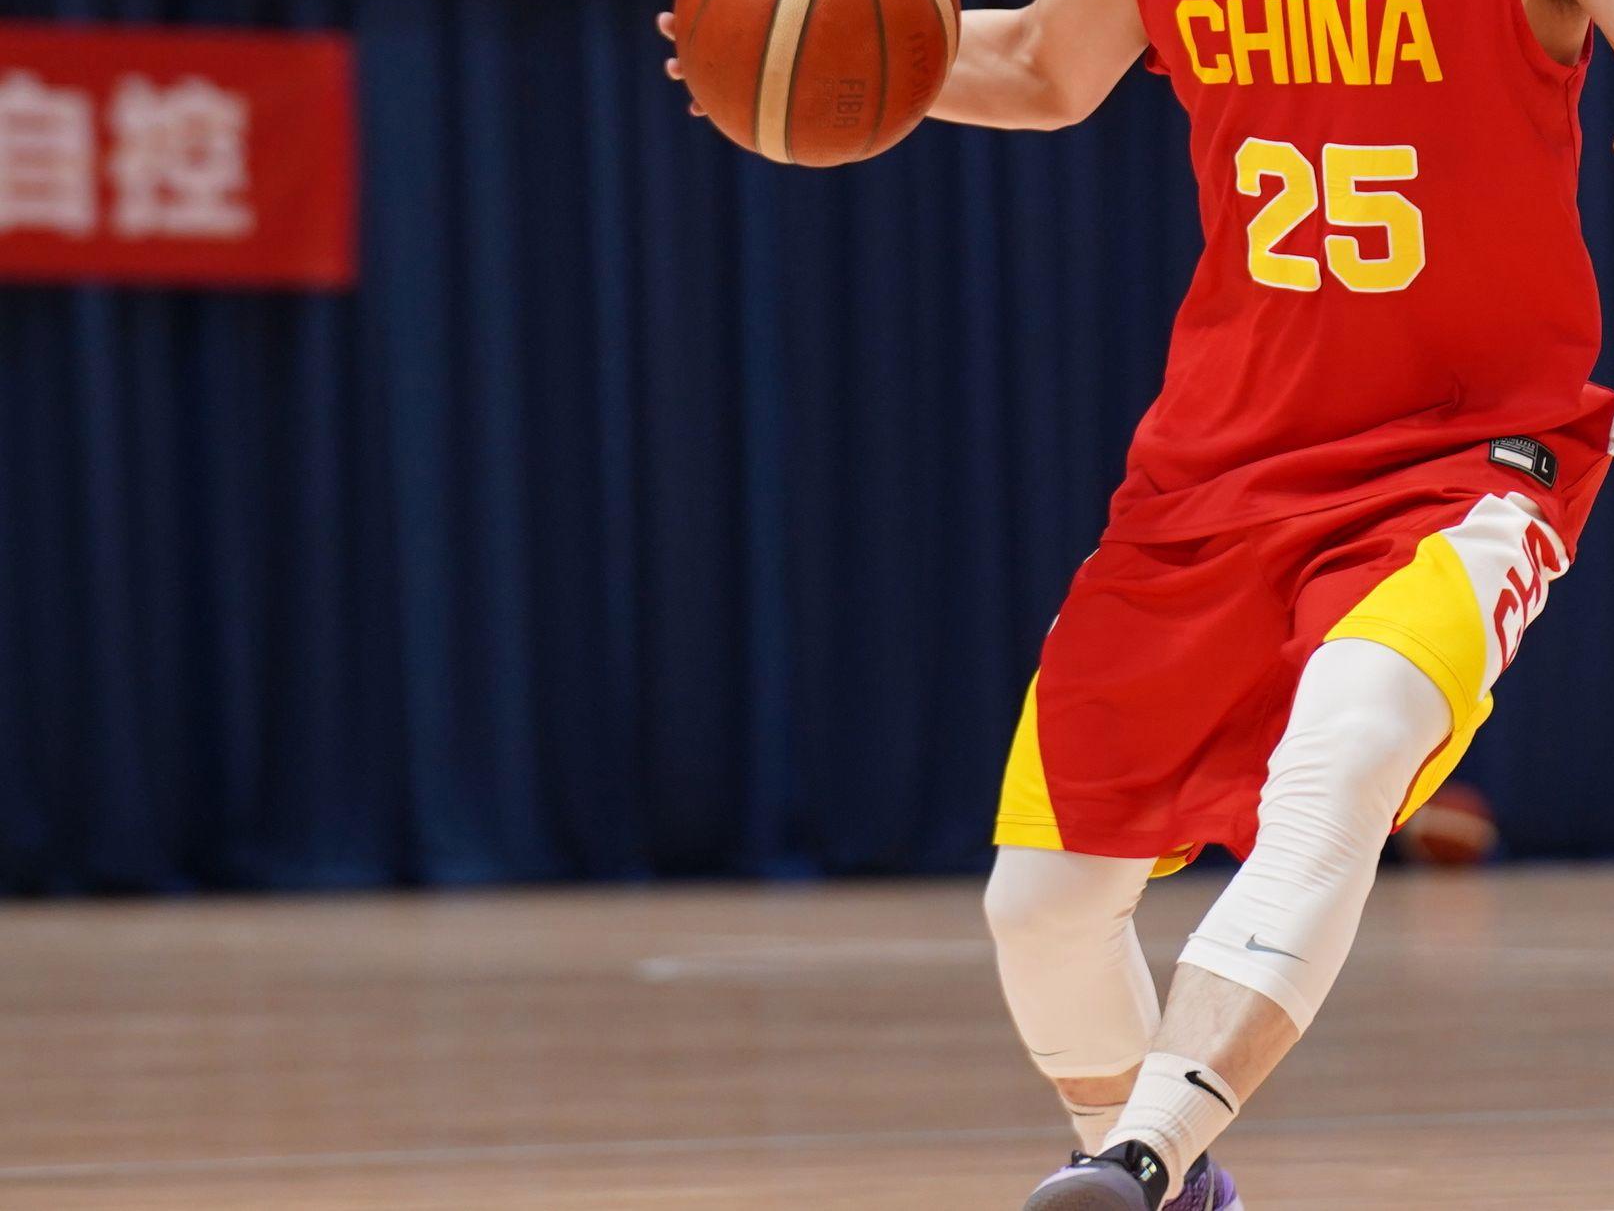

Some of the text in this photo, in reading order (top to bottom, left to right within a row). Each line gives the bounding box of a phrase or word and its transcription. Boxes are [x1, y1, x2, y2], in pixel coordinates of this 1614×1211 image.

[832, 77, 867, 130] FIBA
[1235, 136, 1426, 293] 25
[1541, 456, 1549, 474] L
